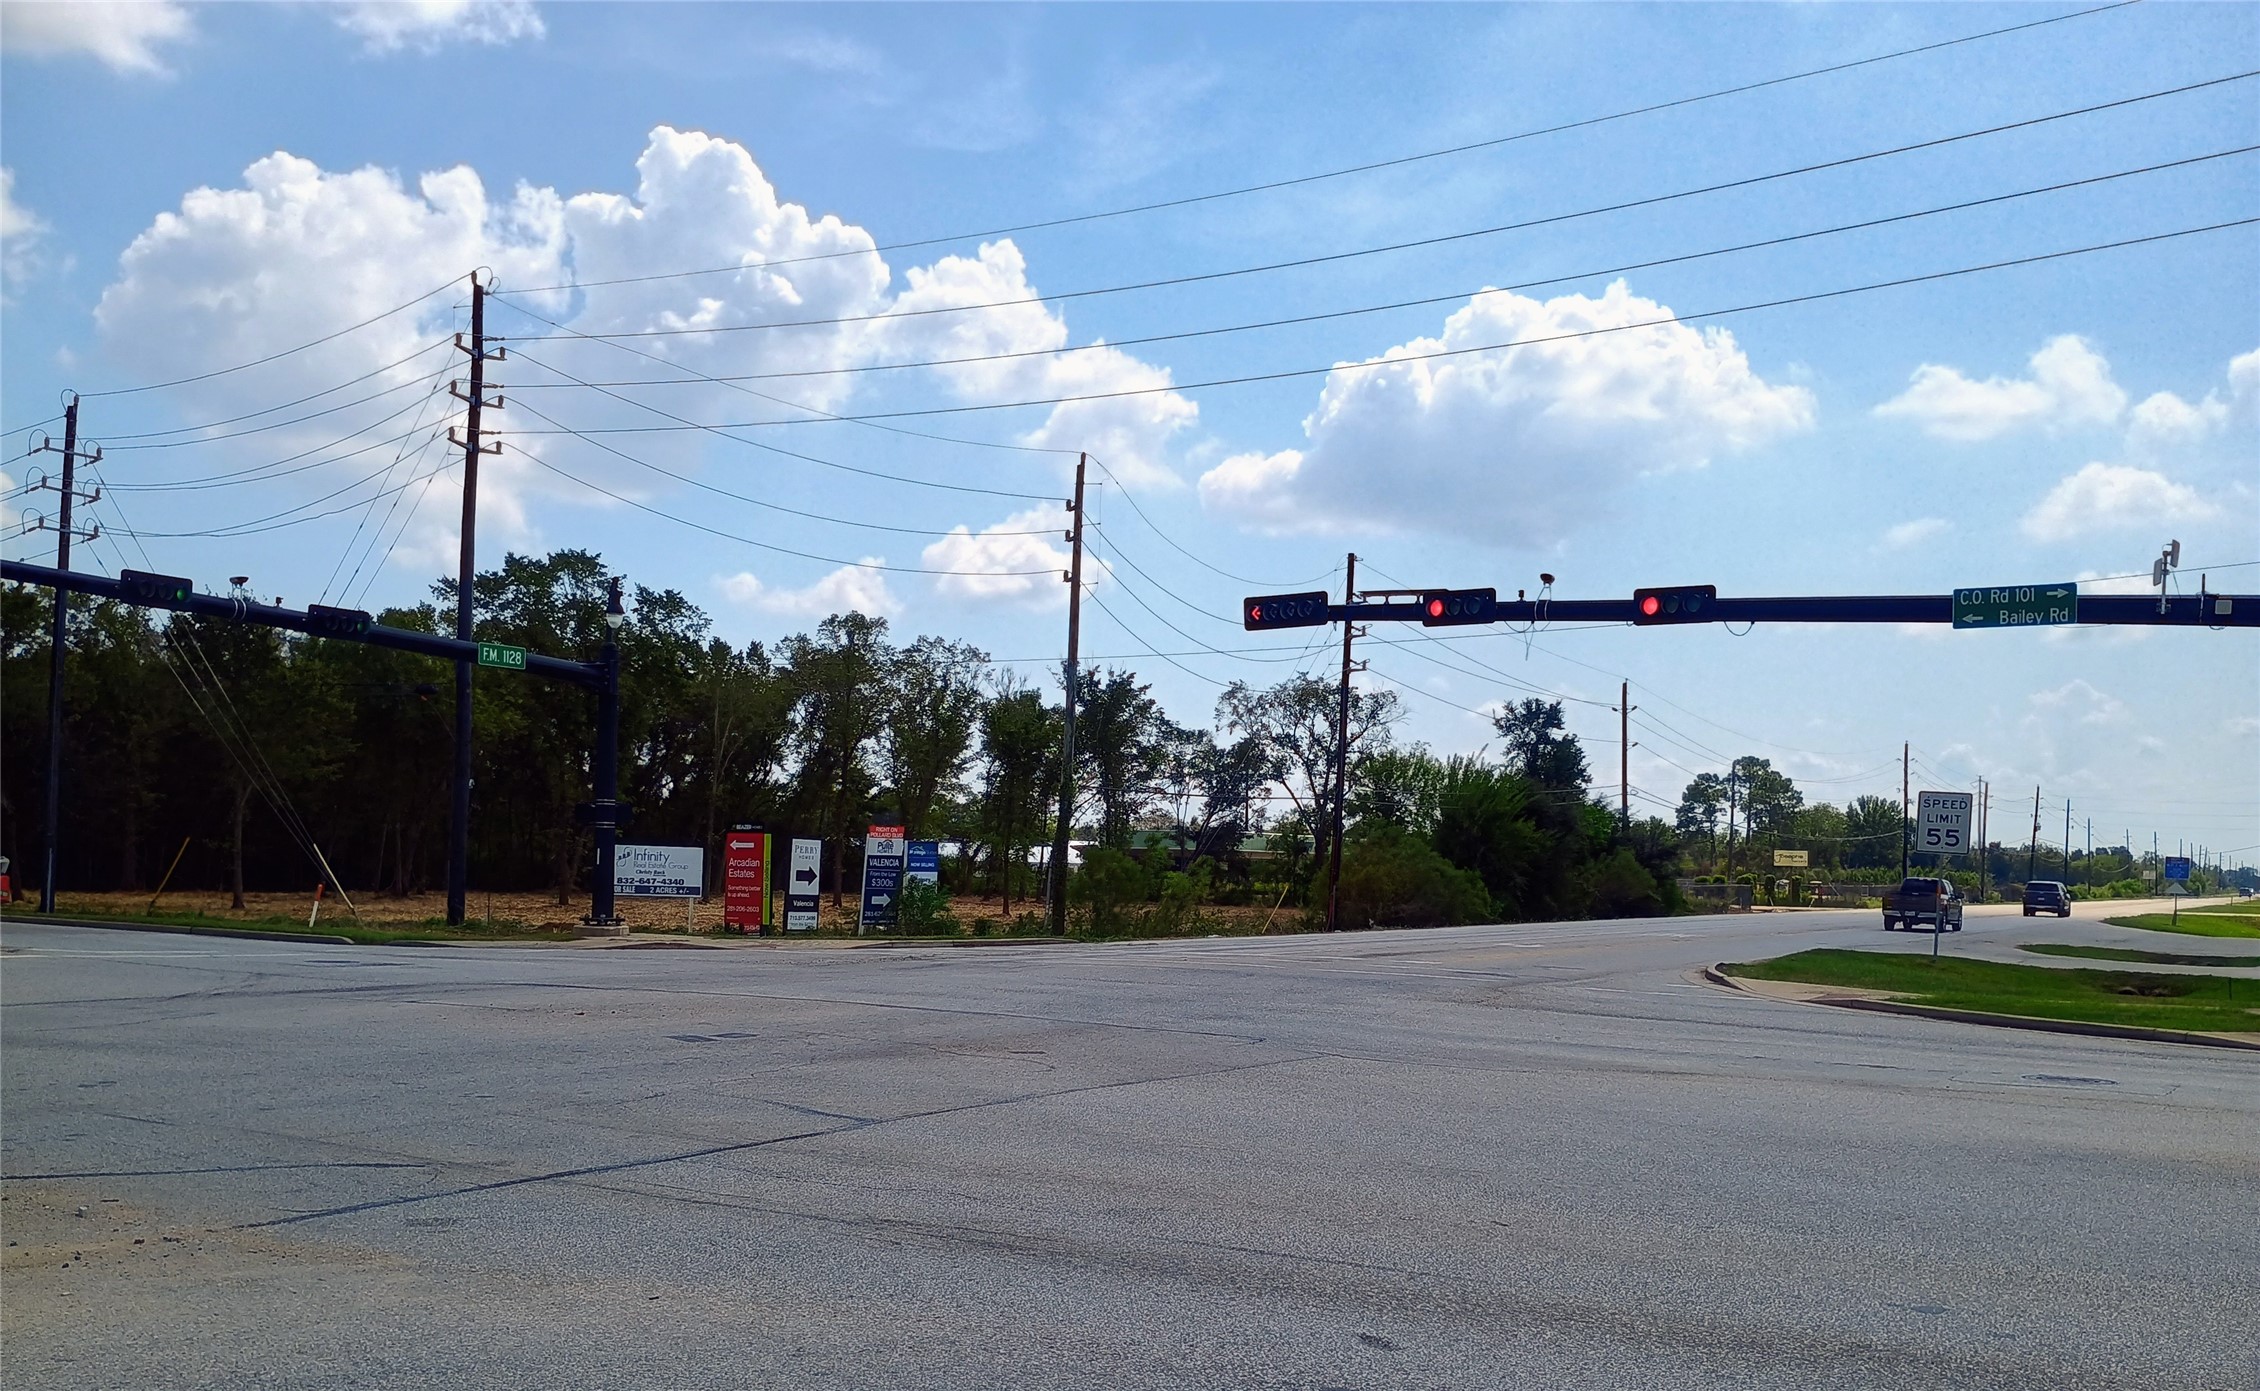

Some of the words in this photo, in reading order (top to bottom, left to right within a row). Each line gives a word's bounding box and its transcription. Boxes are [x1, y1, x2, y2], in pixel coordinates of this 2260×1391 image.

[1960, 590, 1985, 605] C.O.
[1990, 588, 2009, 604] Rd
[2015, 587, 2035, 602] 101
[1999, 609, 2044, 625] Bailey
[2049, 607, 2069, 622] Rd
[483, 647, 500, 662] F.M.
[503, 650, 522, 665] 1128
[1923, 798, 1968, 810] SPEED
[1926, 813, 1962, 824] LIMIT
[1926, 827, 1960, 847] 55
[795, 845, 819, 854] PERRY
[877, 840, 895, 850] Pulte
[634, 848, 670, 864] Infinity
[633, 861, 647, 869] Real
[648, 861, 667, 869] Estate
[668, 862, 689, 870] Group
[728, 858, 761, 867] Arcadian
[869, 859, 899, 867] VALENCIA
[728, 869, 755, 878] Estates
[616, 877, 684, 886] 832-647-4340
[871, 878, 894, 887] $300s
[727, 884, 748, 892] Something
